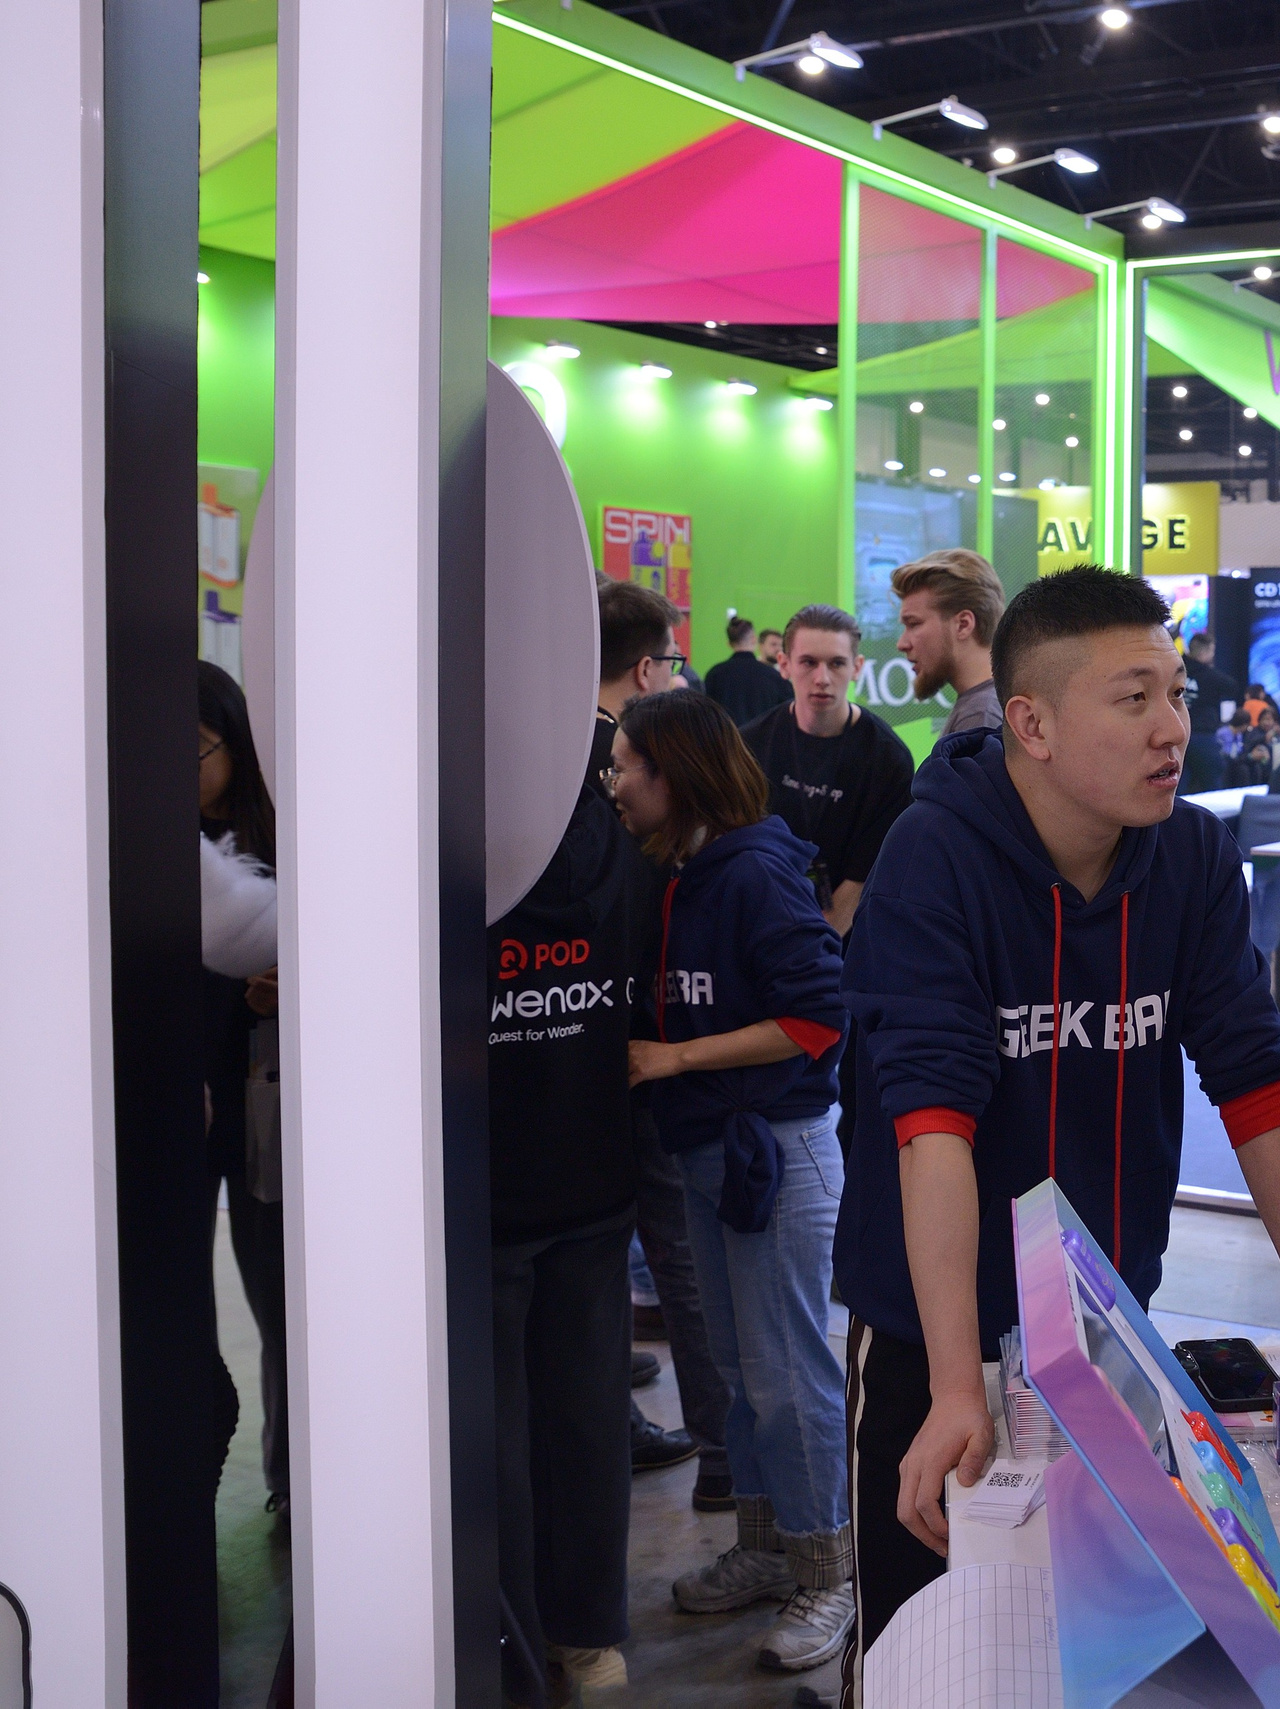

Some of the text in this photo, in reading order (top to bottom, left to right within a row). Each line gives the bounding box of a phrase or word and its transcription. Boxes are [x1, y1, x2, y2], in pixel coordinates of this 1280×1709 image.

[605, 509, 690, 545] SPIN
[1254, 581, 1278, 598] CD
[535, 939, 590, 970] POD
[491, 978, 614, 1023] wenax
[488, 1022, 585, 1045] Quest for Wonder.
[996, 1000, 1094, 1059] GEEK
